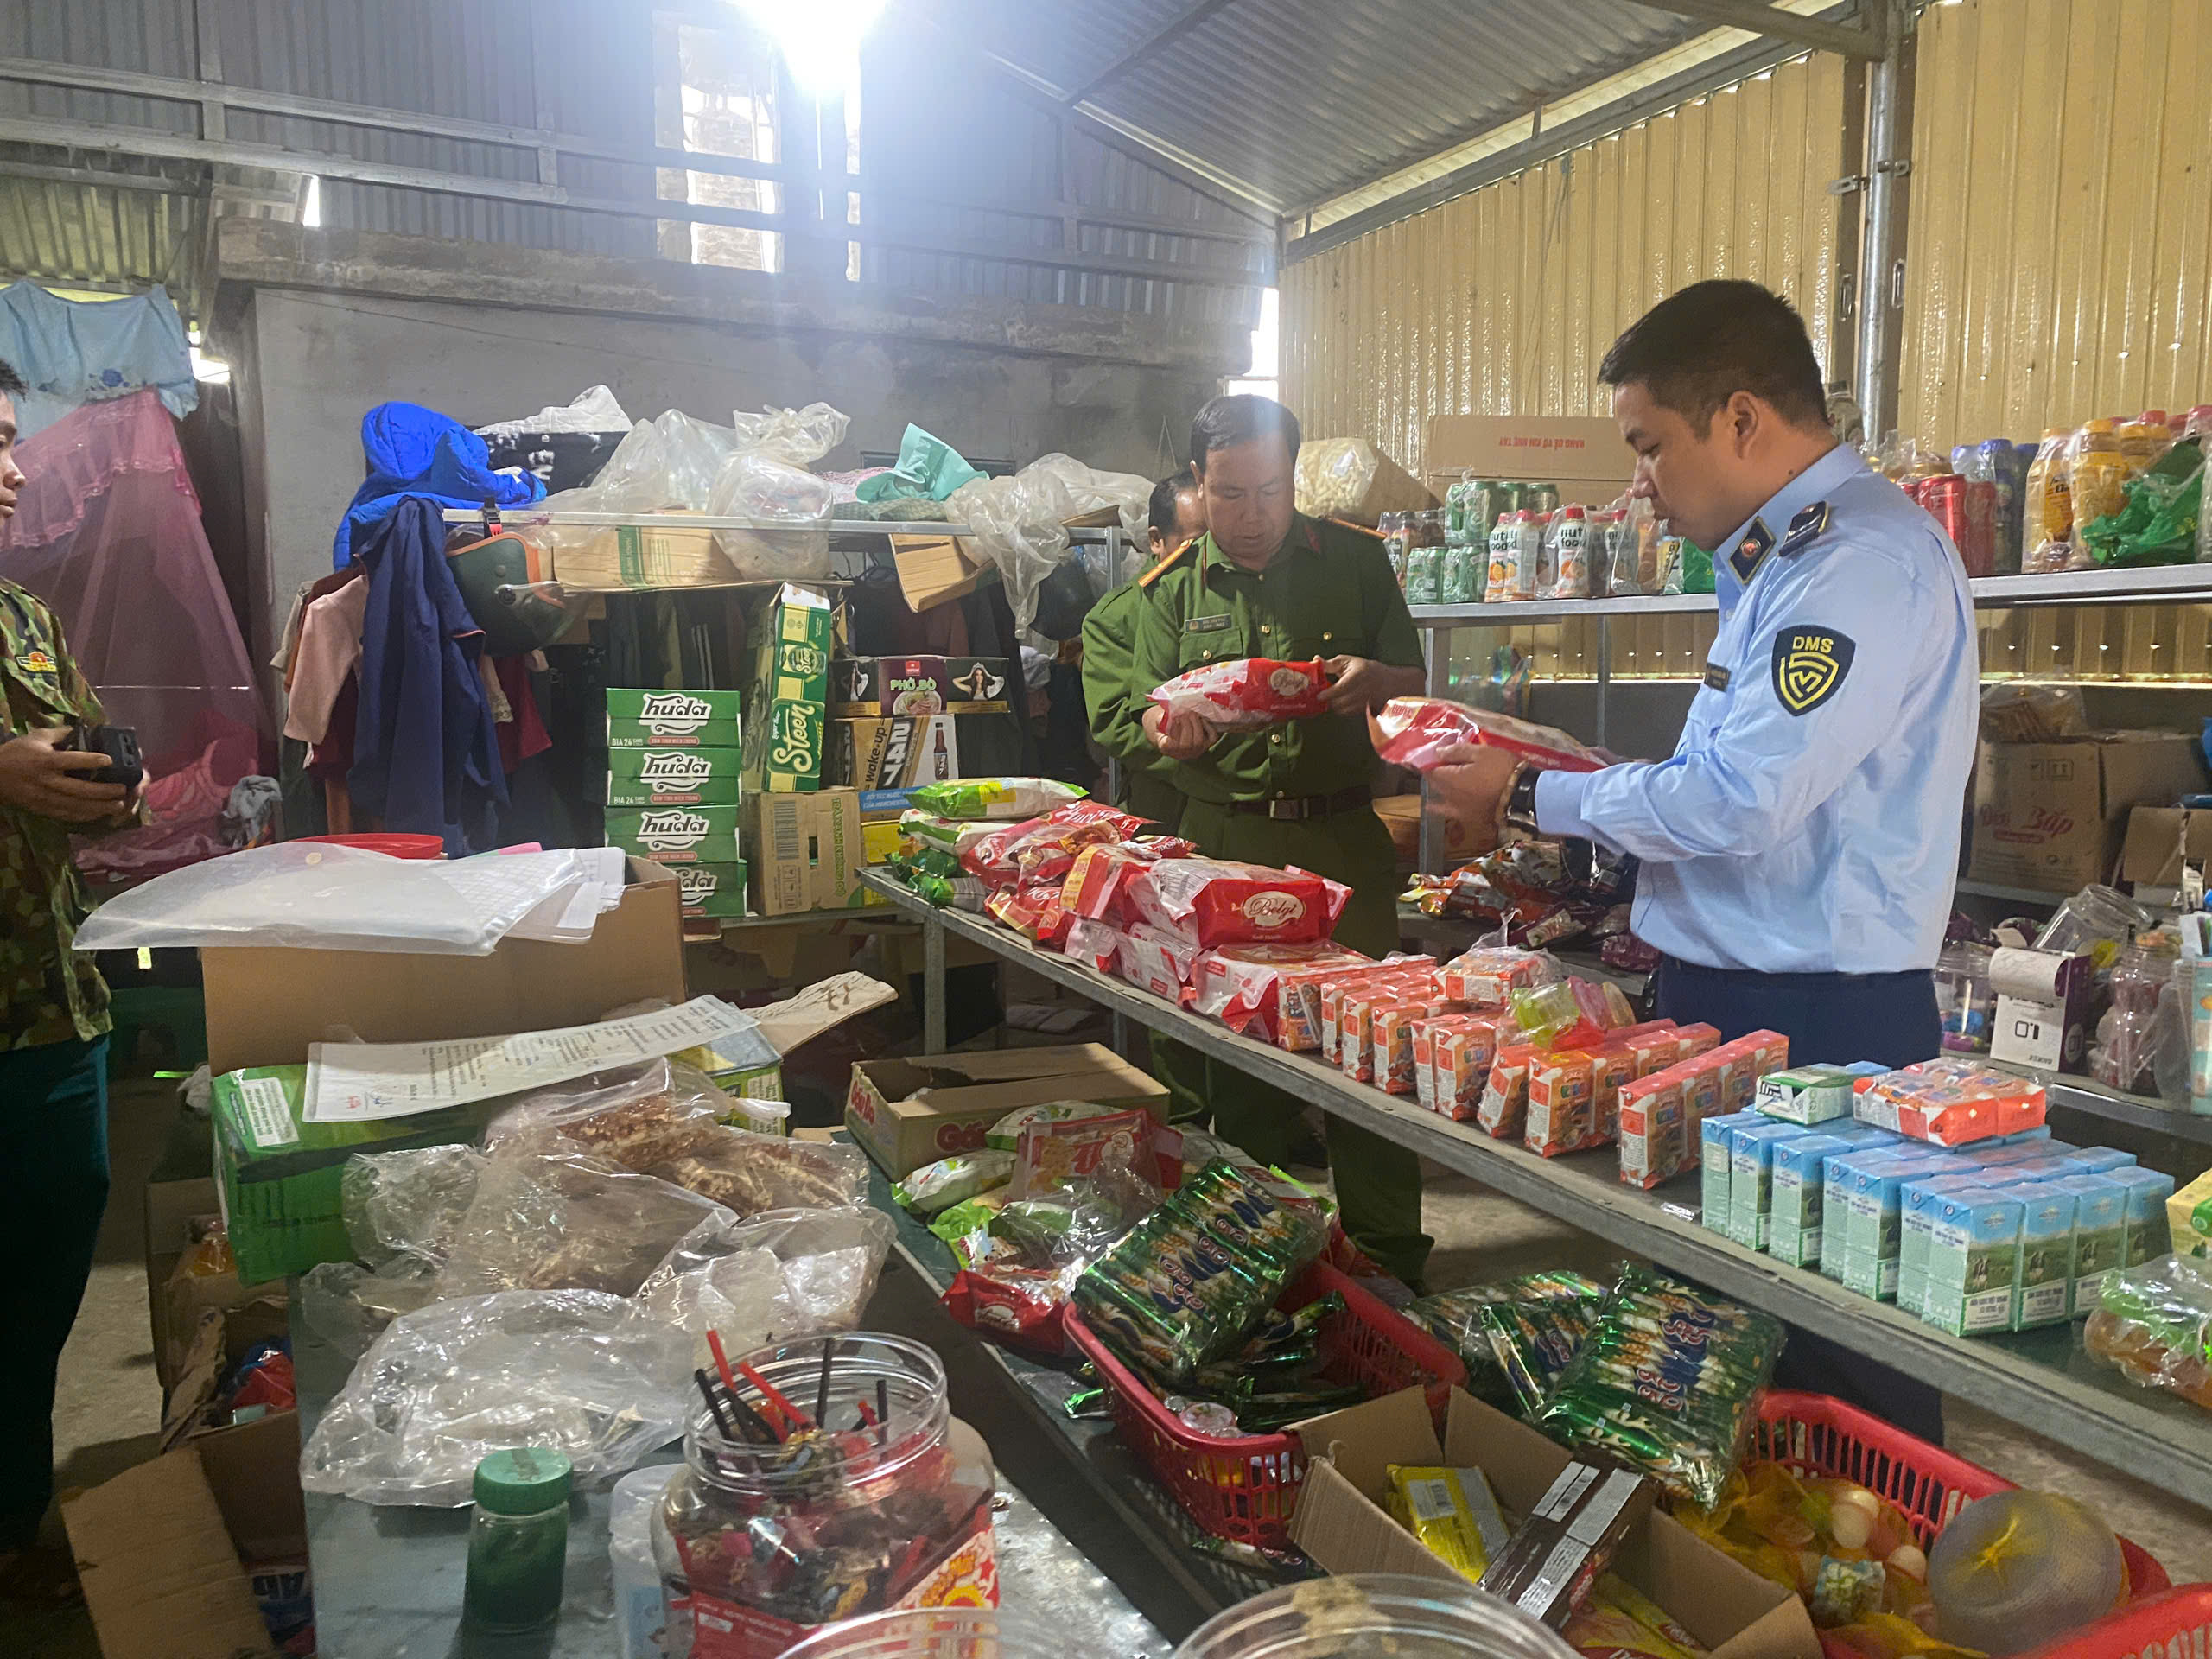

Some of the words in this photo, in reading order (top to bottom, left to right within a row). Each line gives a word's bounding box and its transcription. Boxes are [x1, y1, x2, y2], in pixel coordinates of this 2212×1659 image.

[1792, 635, 1834, 653] DMS
[644, 695, 709, 716] huda
[612, 738, 623, 747] BIA
[773, 703, 815, 772] Steen
[645, 753, 709, 774] huda
[865, 726, 888, 784] wake-up
[641, 812, 707, 833] huda
[1249, 897, 1297, 921] Belgi
